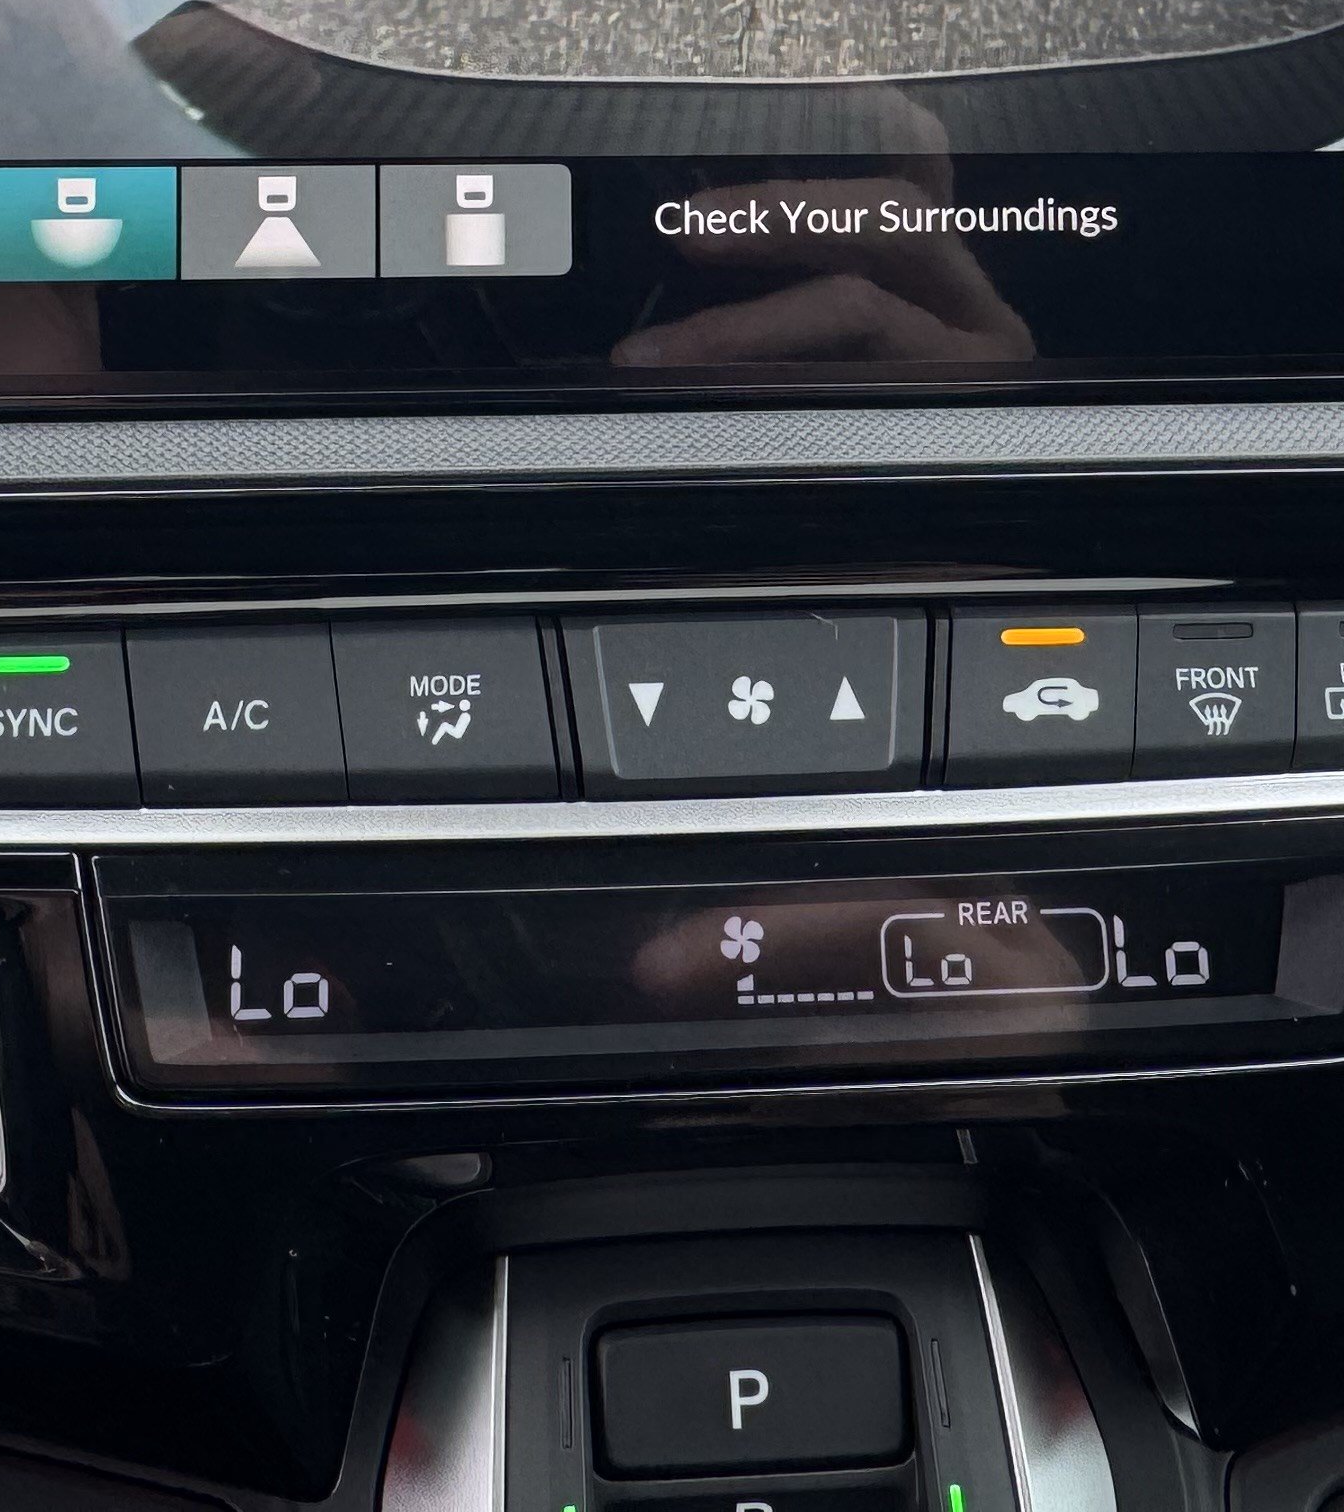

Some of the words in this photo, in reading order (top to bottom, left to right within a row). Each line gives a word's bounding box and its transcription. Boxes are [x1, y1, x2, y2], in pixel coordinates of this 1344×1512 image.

[654, 199, 770, 235] Check
[779, 200, 869, 234] Your
[879, 197, 1119, 239] Surroundings
[410, 674, 482, 698] MODE
[1175, 666, 1260, 691] FRONT
[202, 699, 270, 732] A/C
[957, 900, 1029, 927] REAR
[903, 934, 973, 987] Lo
[1113, 914, 1211, 988] Lo
[230, 944, 330, 1021] Lo
[729, 1369, 770, 1430] P
